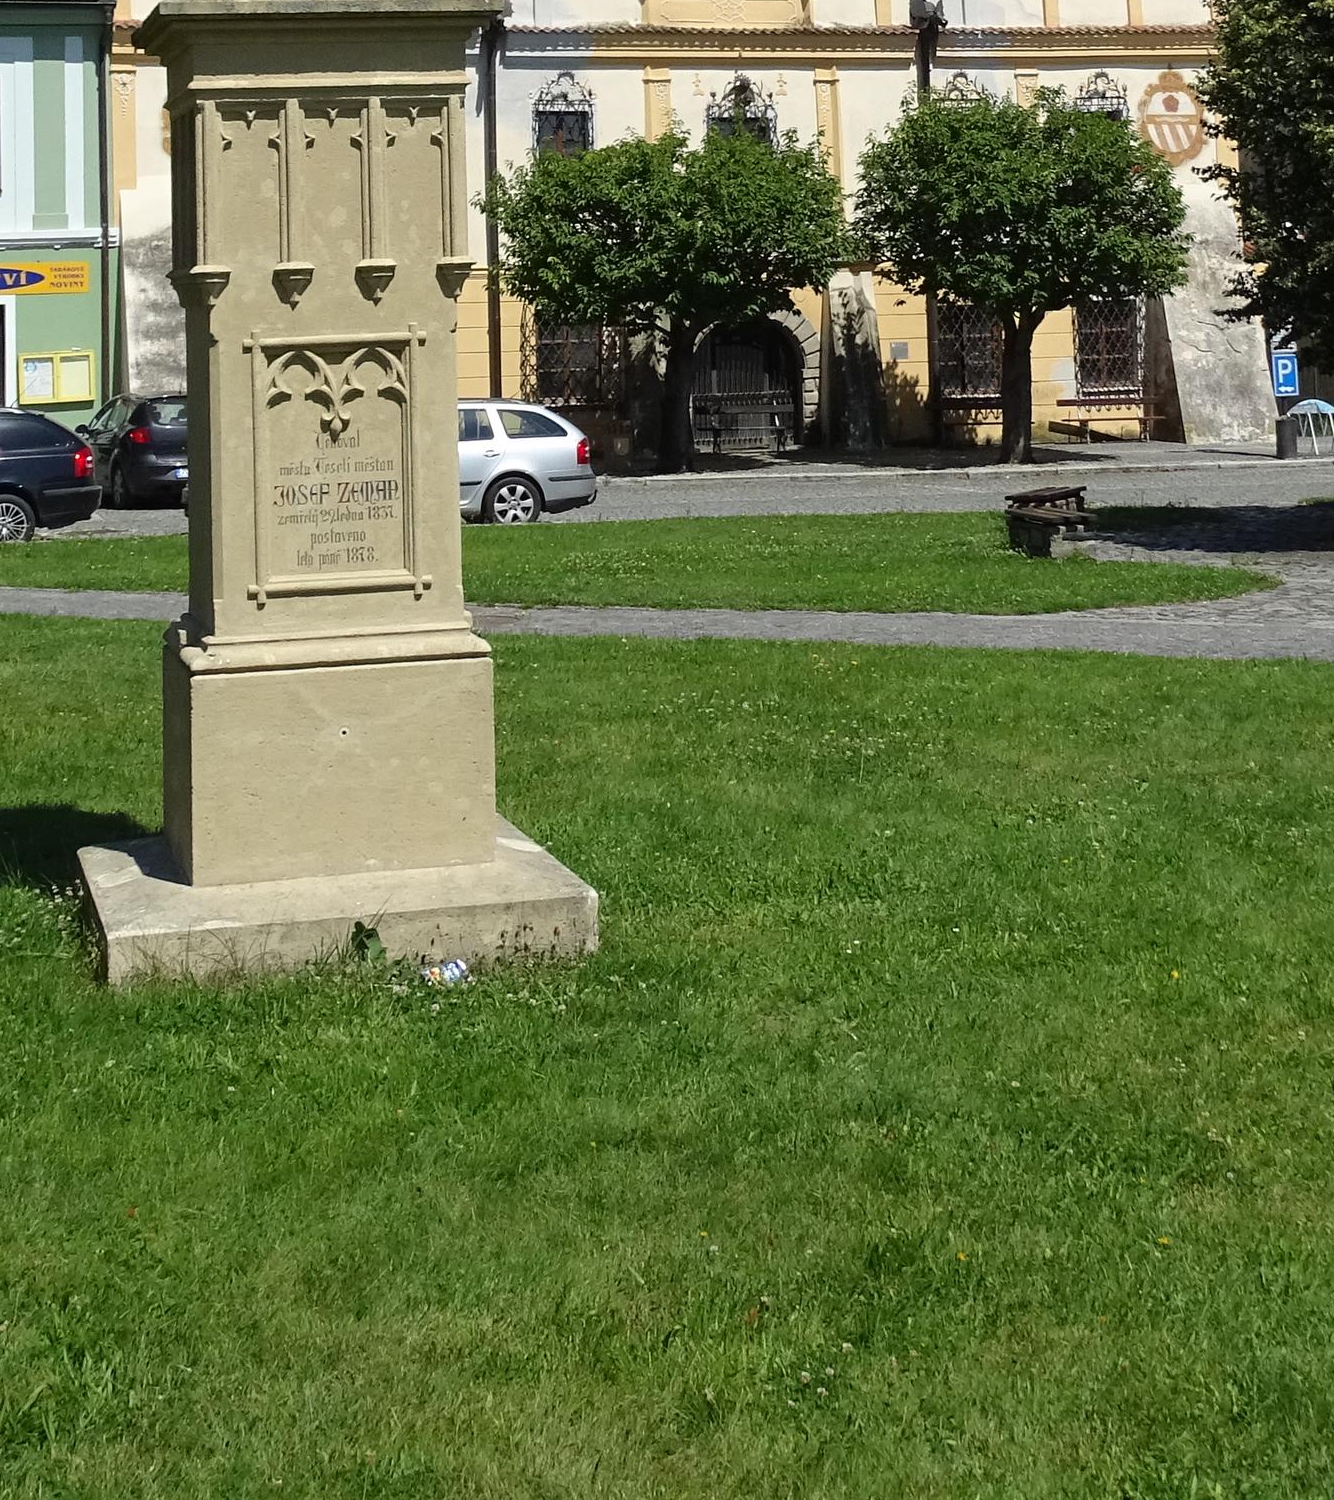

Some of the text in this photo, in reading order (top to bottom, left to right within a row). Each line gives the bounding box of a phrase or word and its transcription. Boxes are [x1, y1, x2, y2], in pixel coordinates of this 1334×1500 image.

[1278, 360, 1292, 383] P
[273, 479, 400, 507] JOSEF ZEMAN
[310, 526, 367, 550] postaveno
